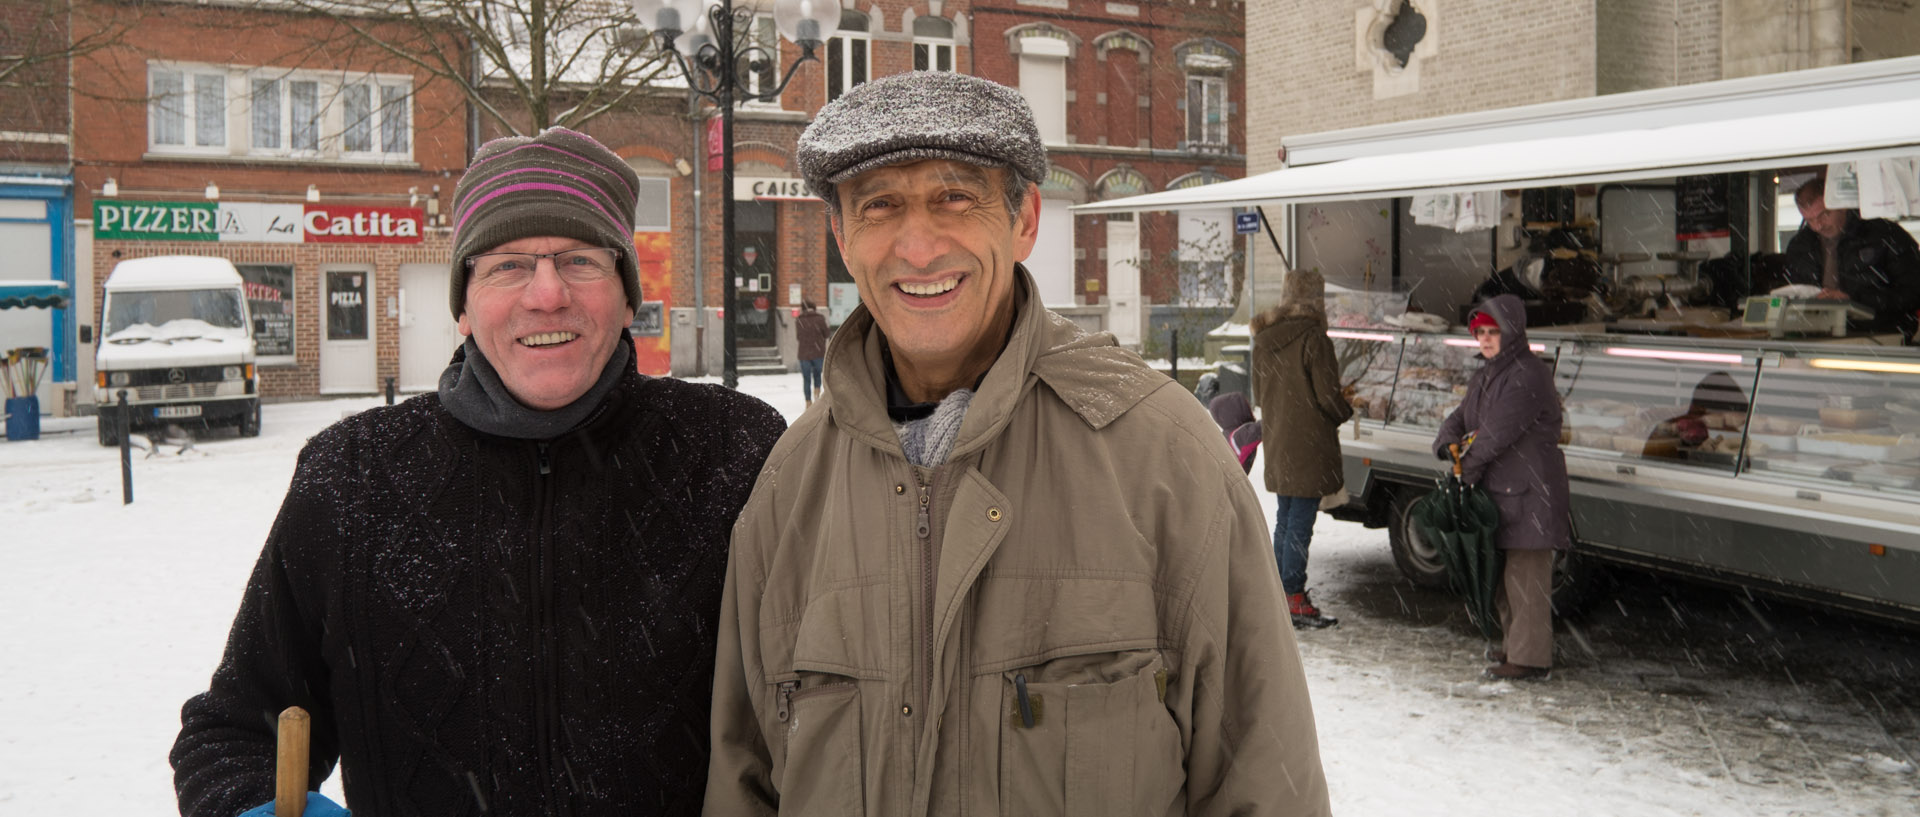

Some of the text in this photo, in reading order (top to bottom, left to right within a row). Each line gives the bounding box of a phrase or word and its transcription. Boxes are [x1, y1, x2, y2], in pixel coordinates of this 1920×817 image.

[99, 205, 418, 237] PIZZERIA La Catita
[331, 292, 362, 305] PIZZA
